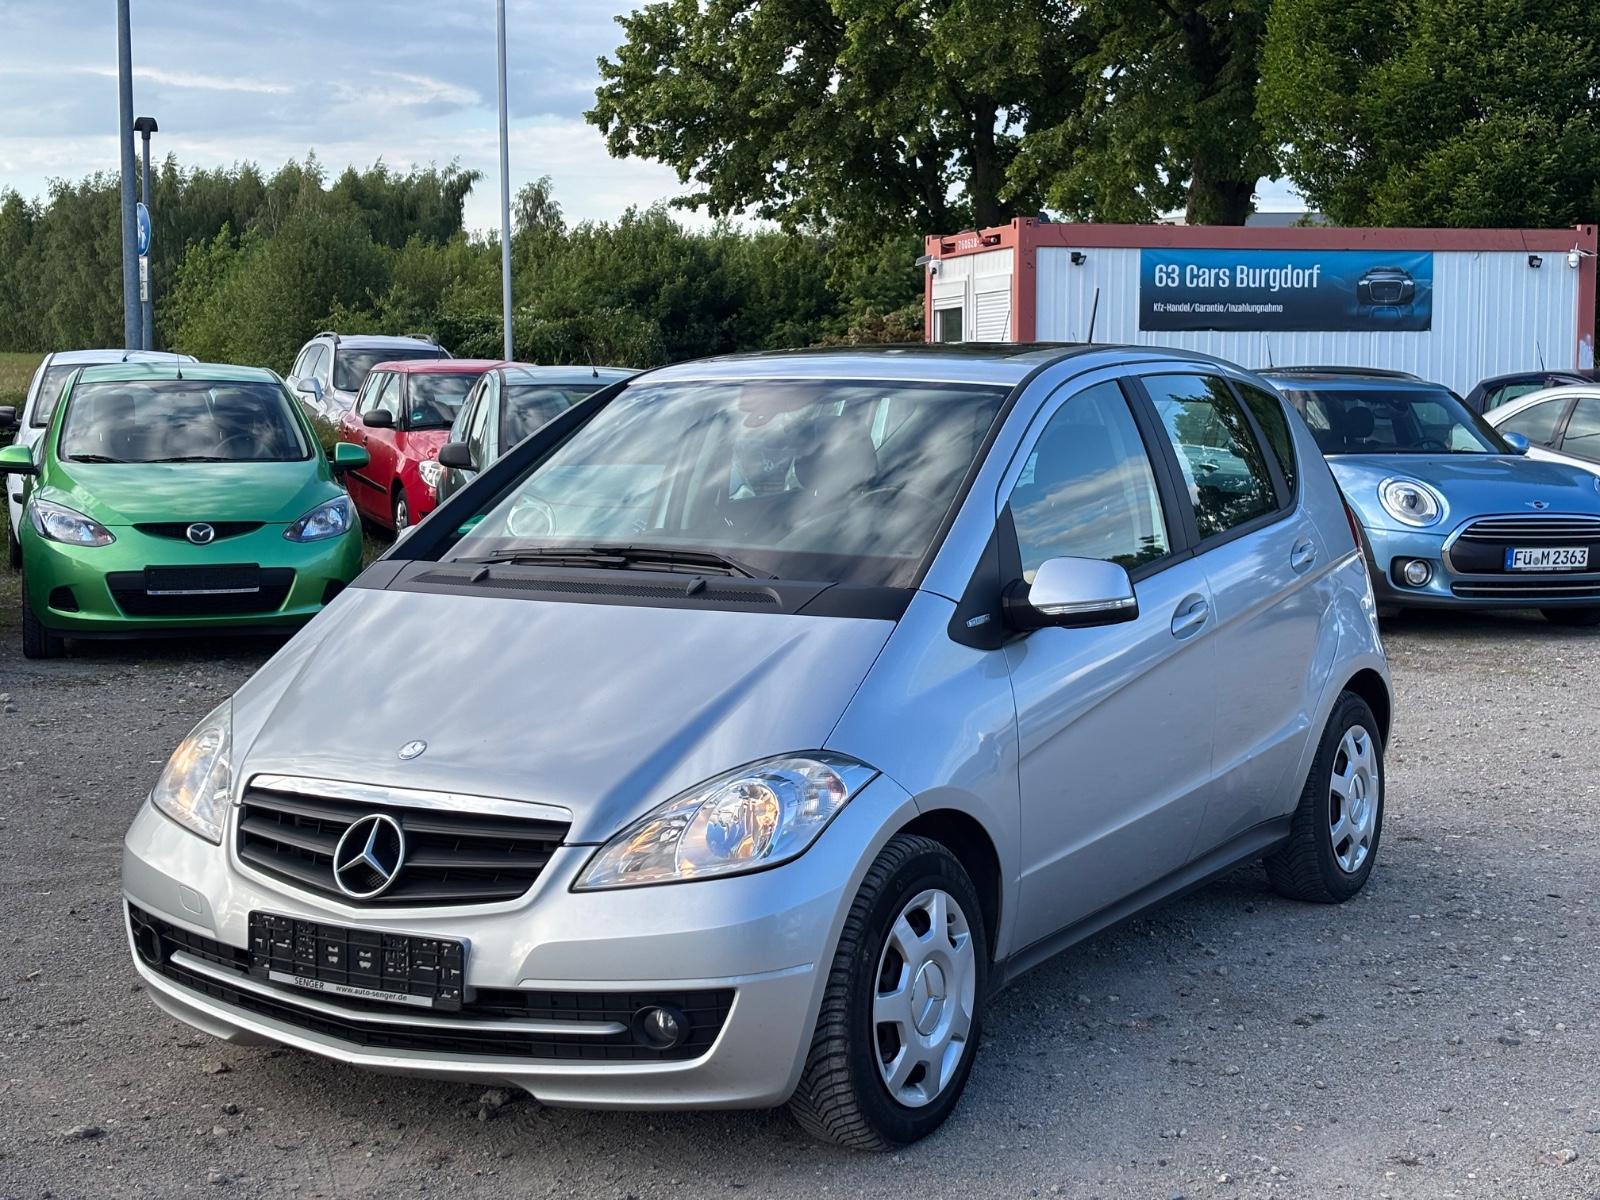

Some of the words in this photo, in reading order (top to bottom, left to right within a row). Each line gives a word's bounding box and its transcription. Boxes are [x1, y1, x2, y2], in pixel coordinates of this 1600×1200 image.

[1154, 264, 1179, 288] 63
[1186, 264, 1230, 288] Cars
[1236, 264, 1321, 292] Burgdorf
[1514, 550, 1533, 566] FÜ
[1552, 550, 1586, 564] 2363
[294, 976, 325, 990] SENGER
[336, 984, 408, 1001] www.auto-senger.de
